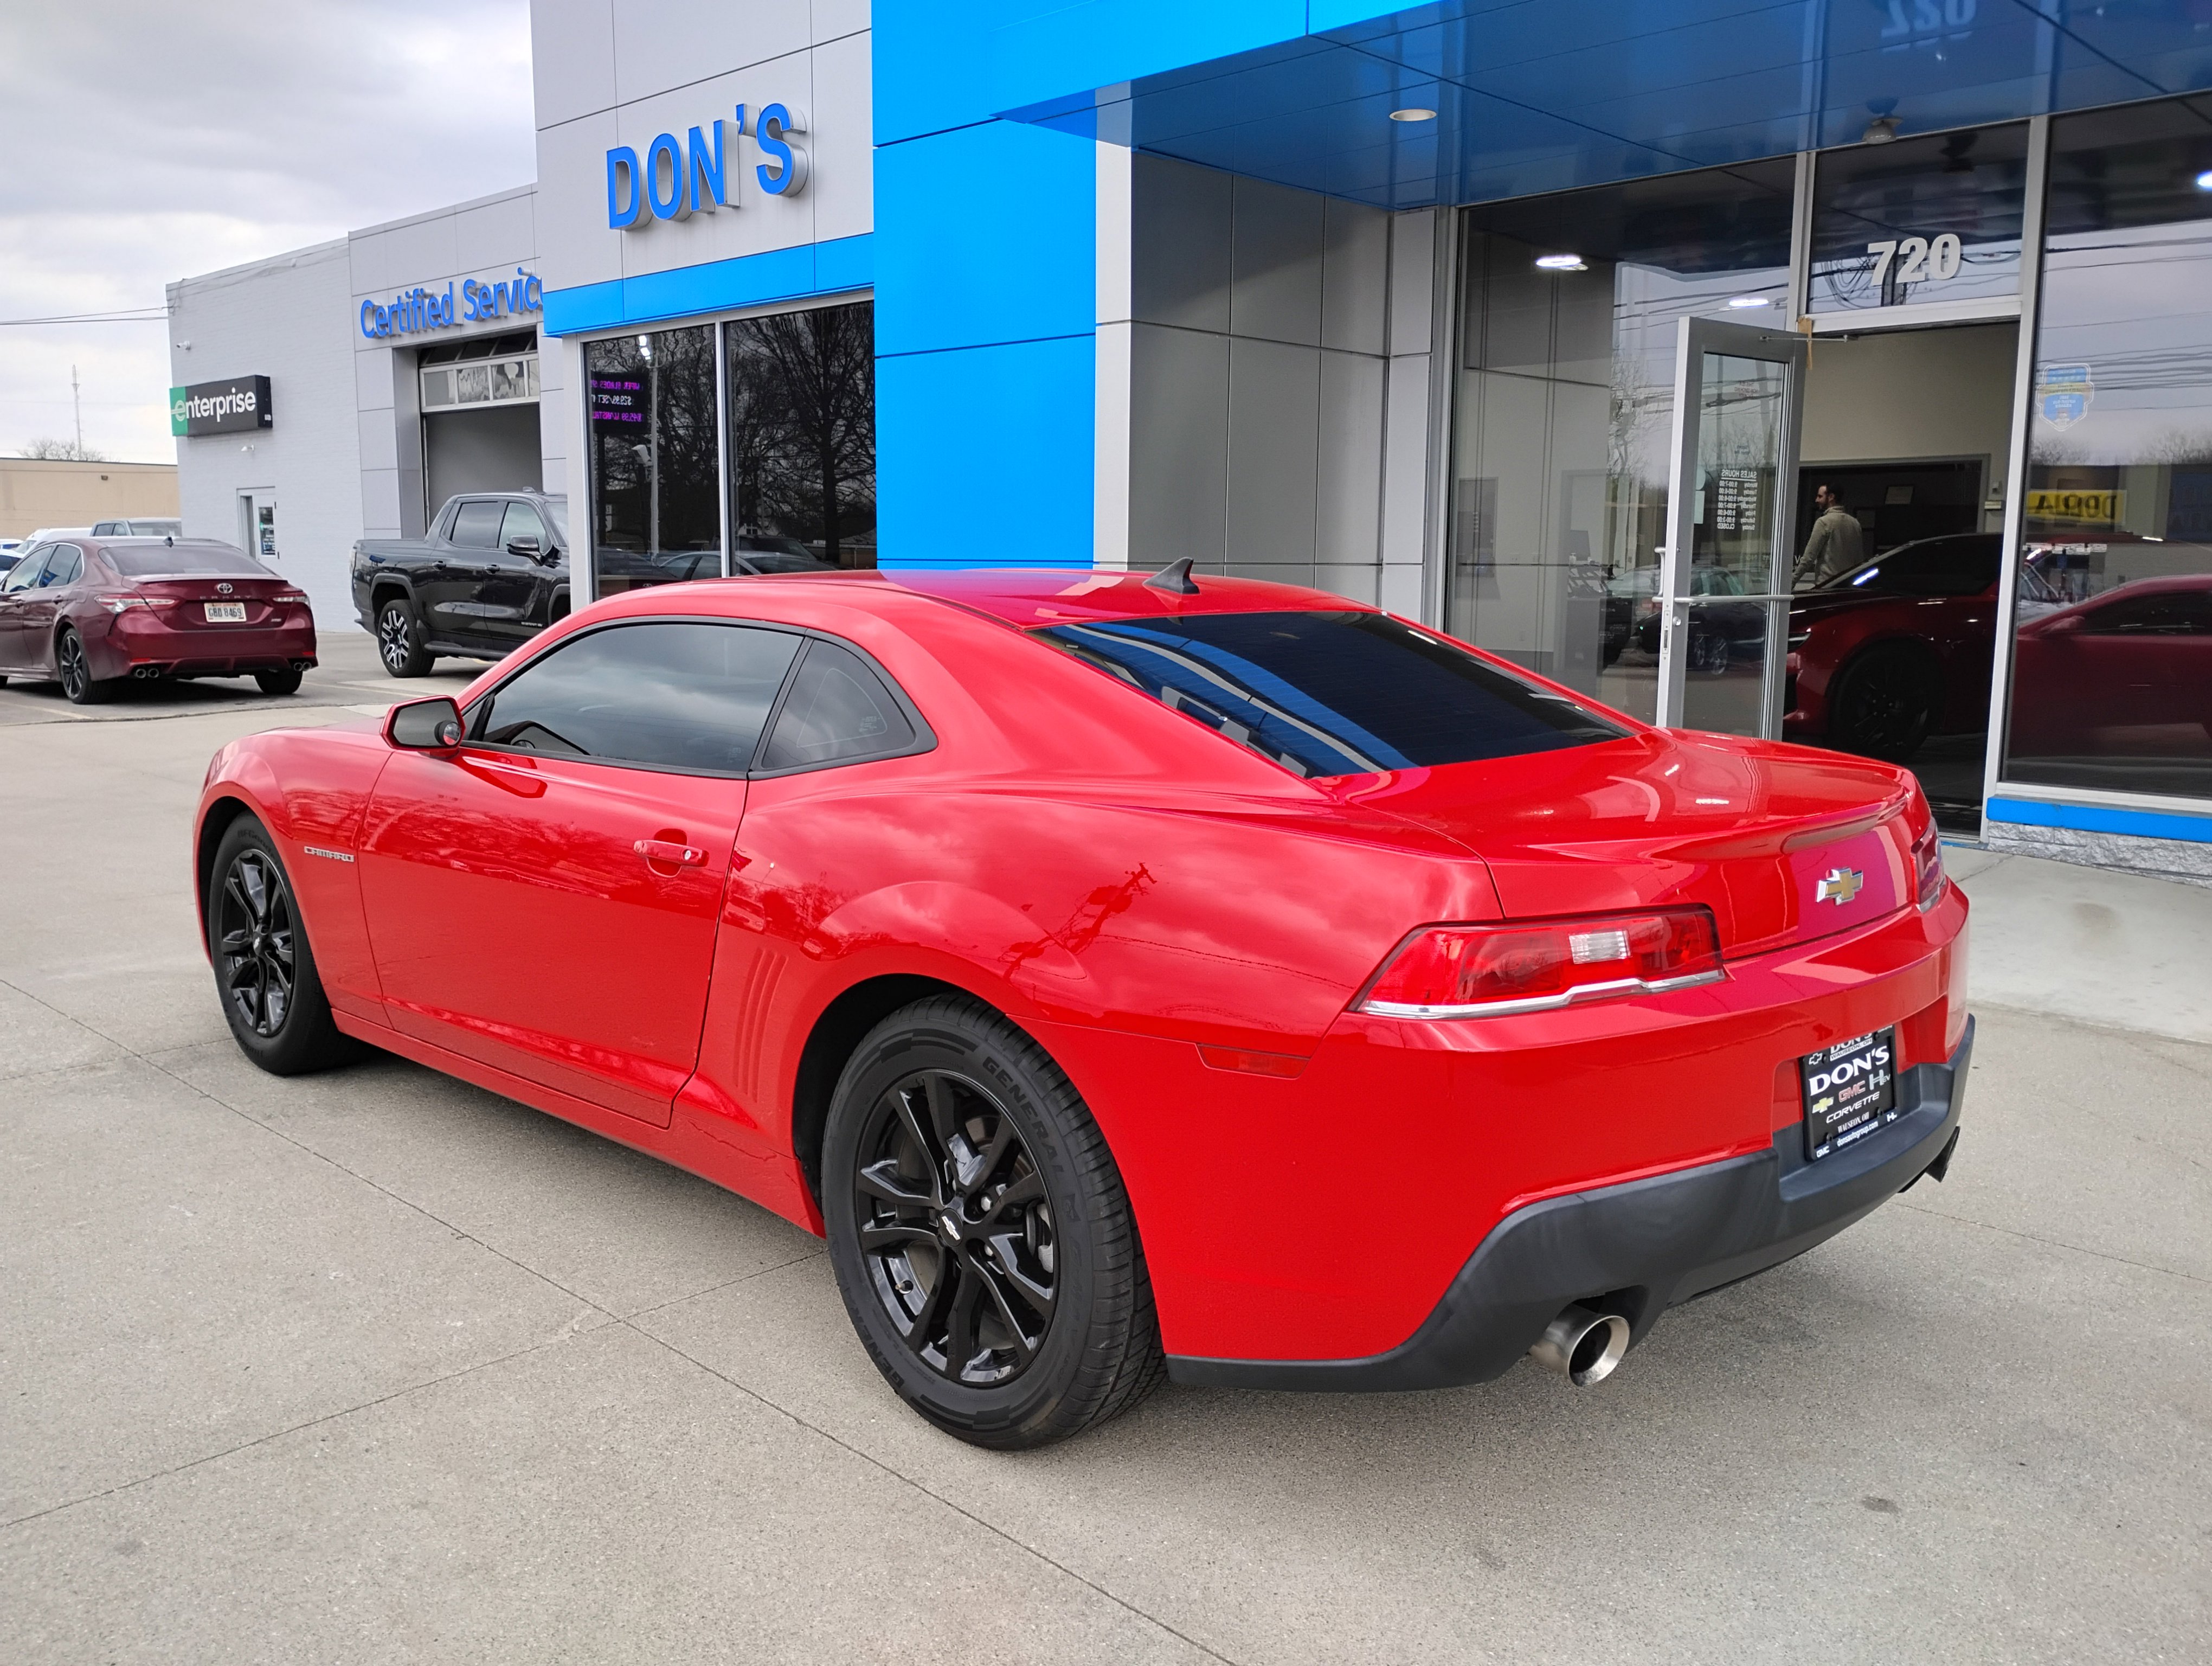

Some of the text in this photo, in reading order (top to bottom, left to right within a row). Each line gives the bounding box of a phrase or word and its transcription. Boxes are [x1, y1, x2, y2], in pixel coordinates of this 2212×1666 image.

[606, 102, 800, 230] DON'S
[1867, 233, 1961, 286] 720
[360, 267, 543, 338] Certified Servic
[171, 387, 256, 422] enterprise
[304, 846, 355, 862] CAMARO
[1831, 1045, 1862, 1060] WAUSEON,
[1809, 1046, 1890, 1096] DON'S
[1826, 1091, 1880, 1124] CORVETTE
[1838, 1080, 1866, 1103] GMC
[982, 1056, 1065, 1181] GENERAL
[1837, 1121, 1879, 1147] donsautogroup.com
[1862, 1112, 1869, 1122] OH
